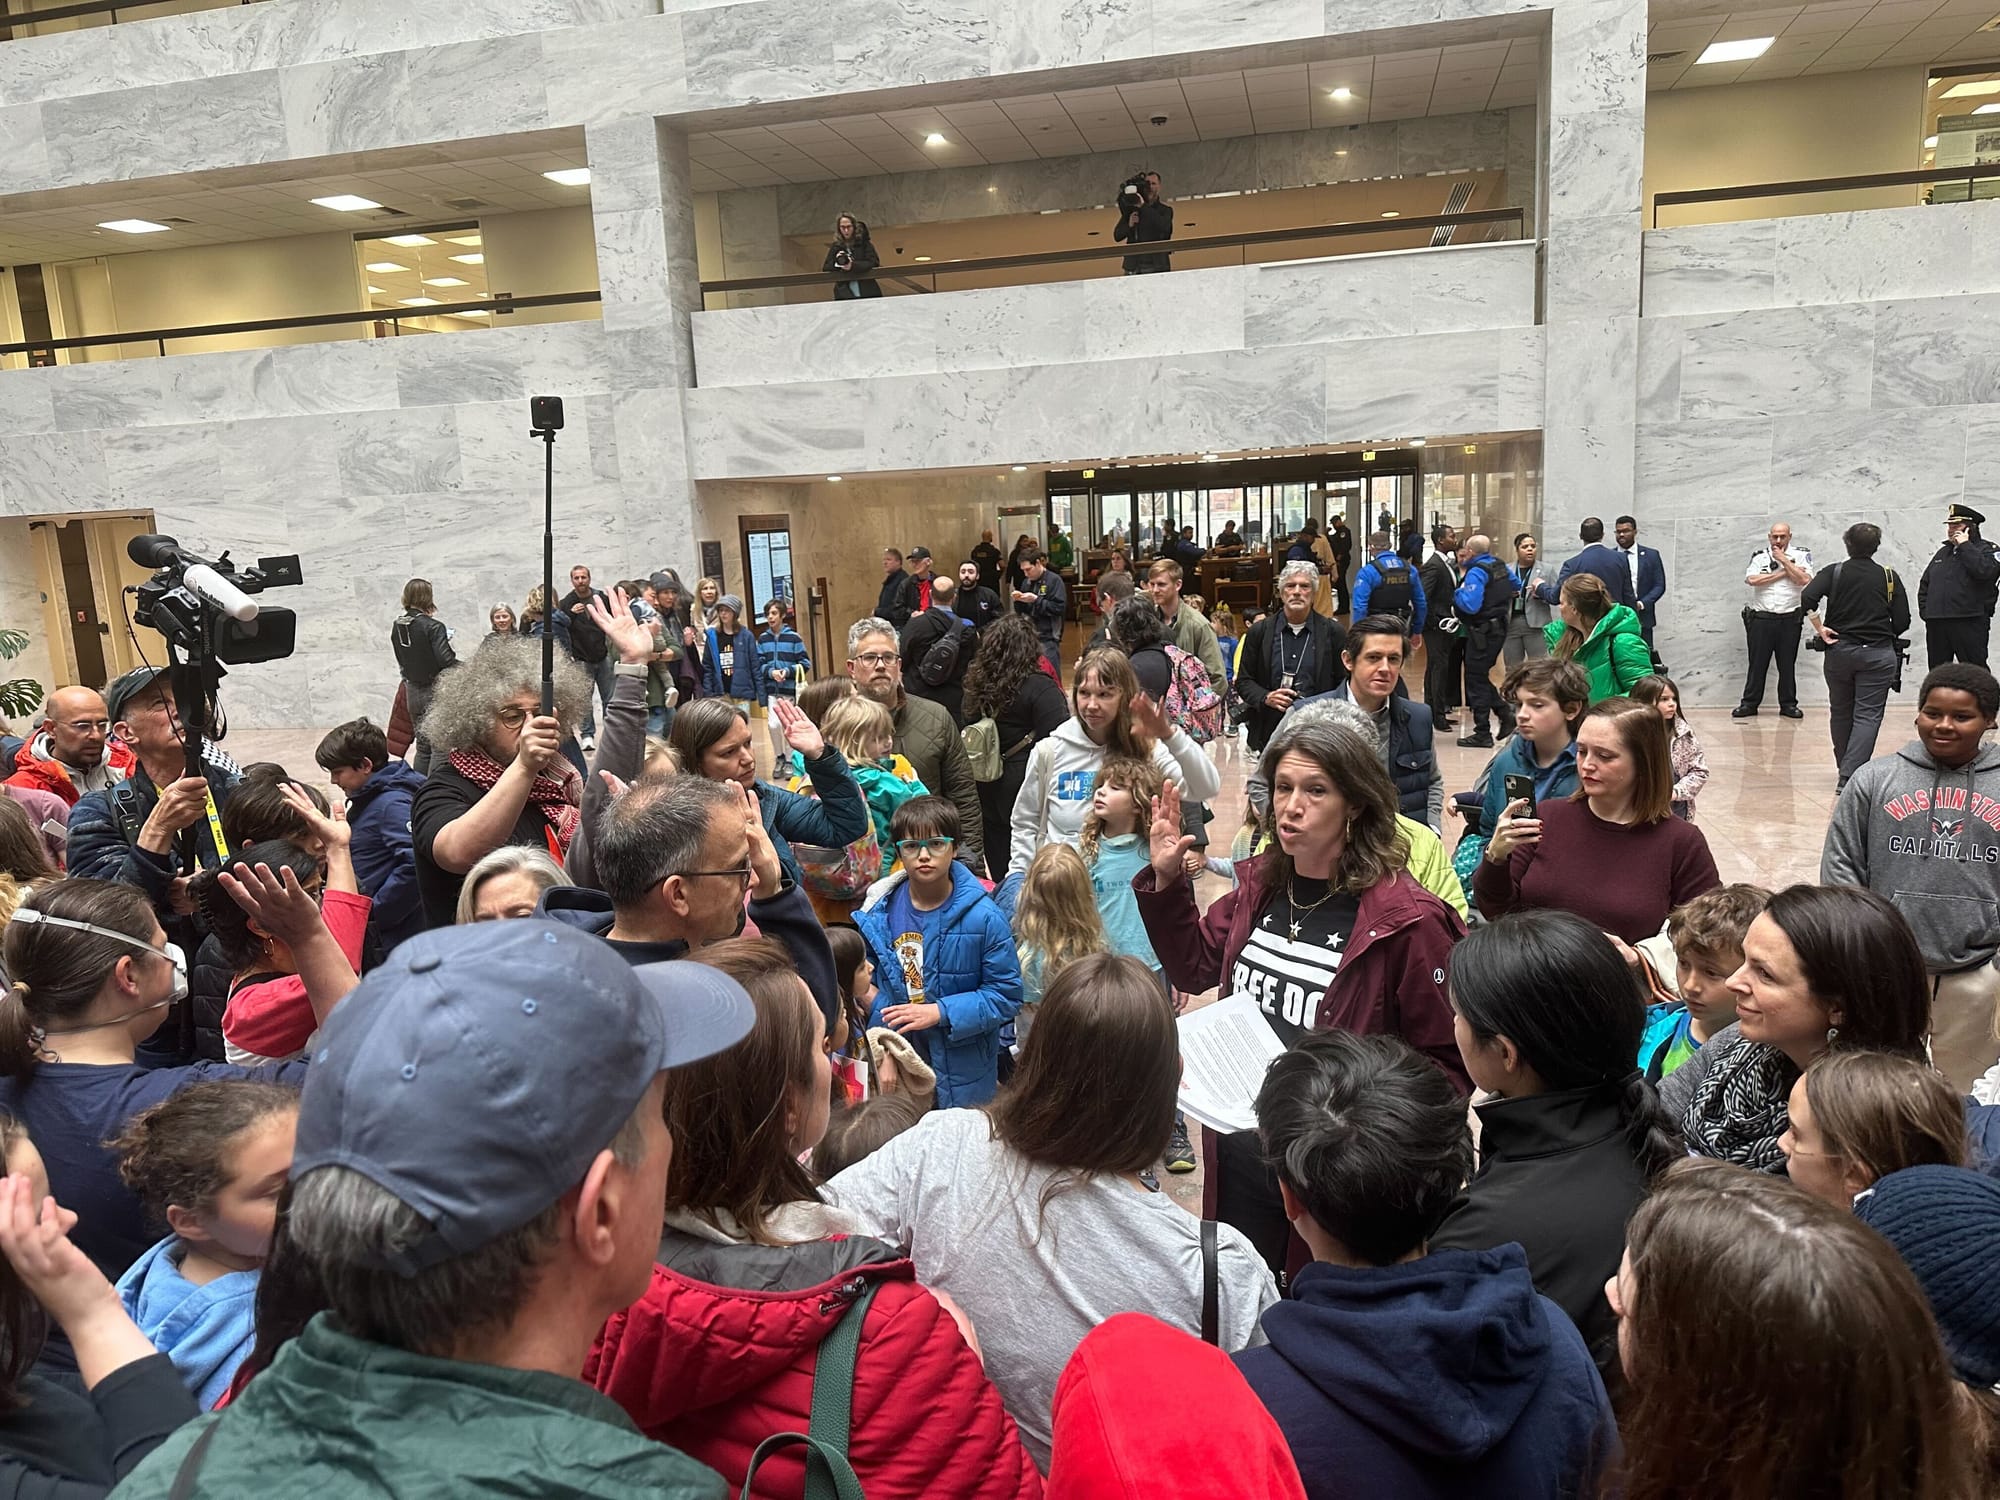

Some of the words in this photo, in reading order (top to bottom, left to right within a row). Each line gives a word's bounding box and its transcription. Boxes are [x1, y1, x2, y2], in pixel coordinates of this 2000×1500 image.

[1386, 576, 1408, 585] POLICE
[197, 585, 225, 608] Reuters
[1232, 961, 1279, 1015] REE
